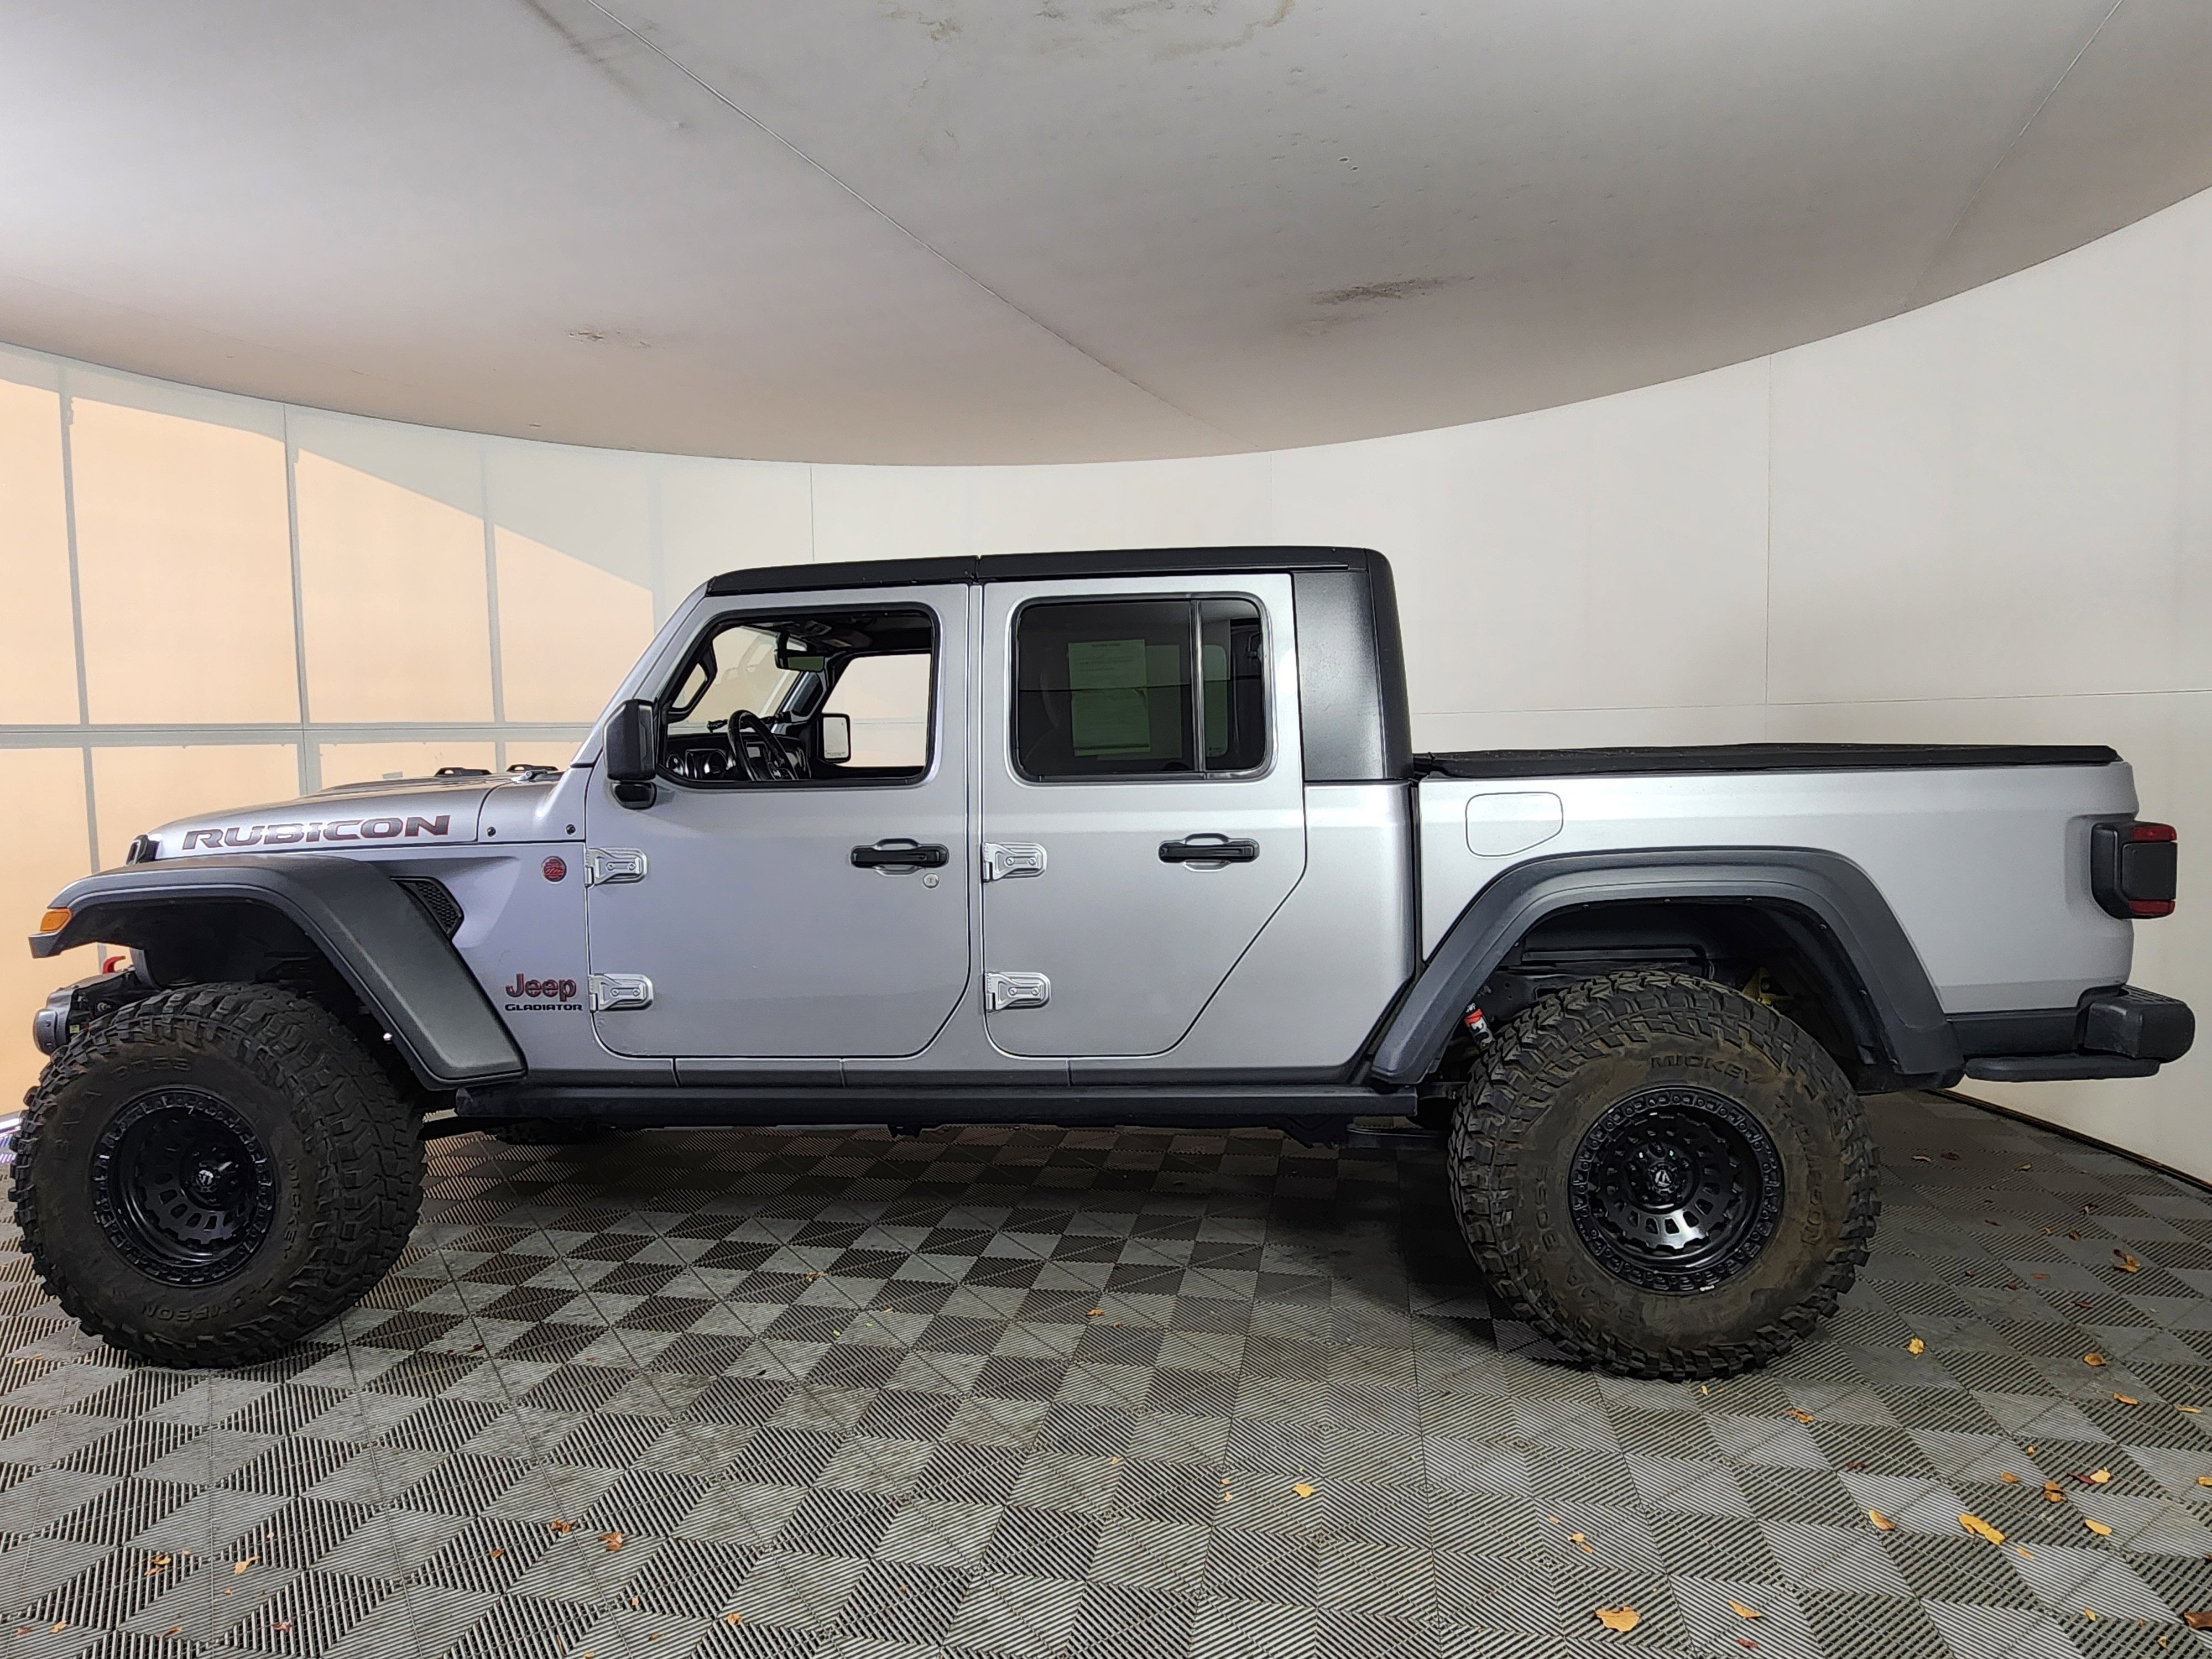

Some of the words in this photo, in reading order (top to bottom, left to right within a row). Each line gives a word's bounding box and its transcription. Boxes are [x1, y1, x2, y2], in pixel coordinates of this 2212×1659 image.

[182, 815, 450, 850] RUBICON
[505, 973, 577, 1002] Jeep
[1651, 1055, 1759, 1084] MICKEY
